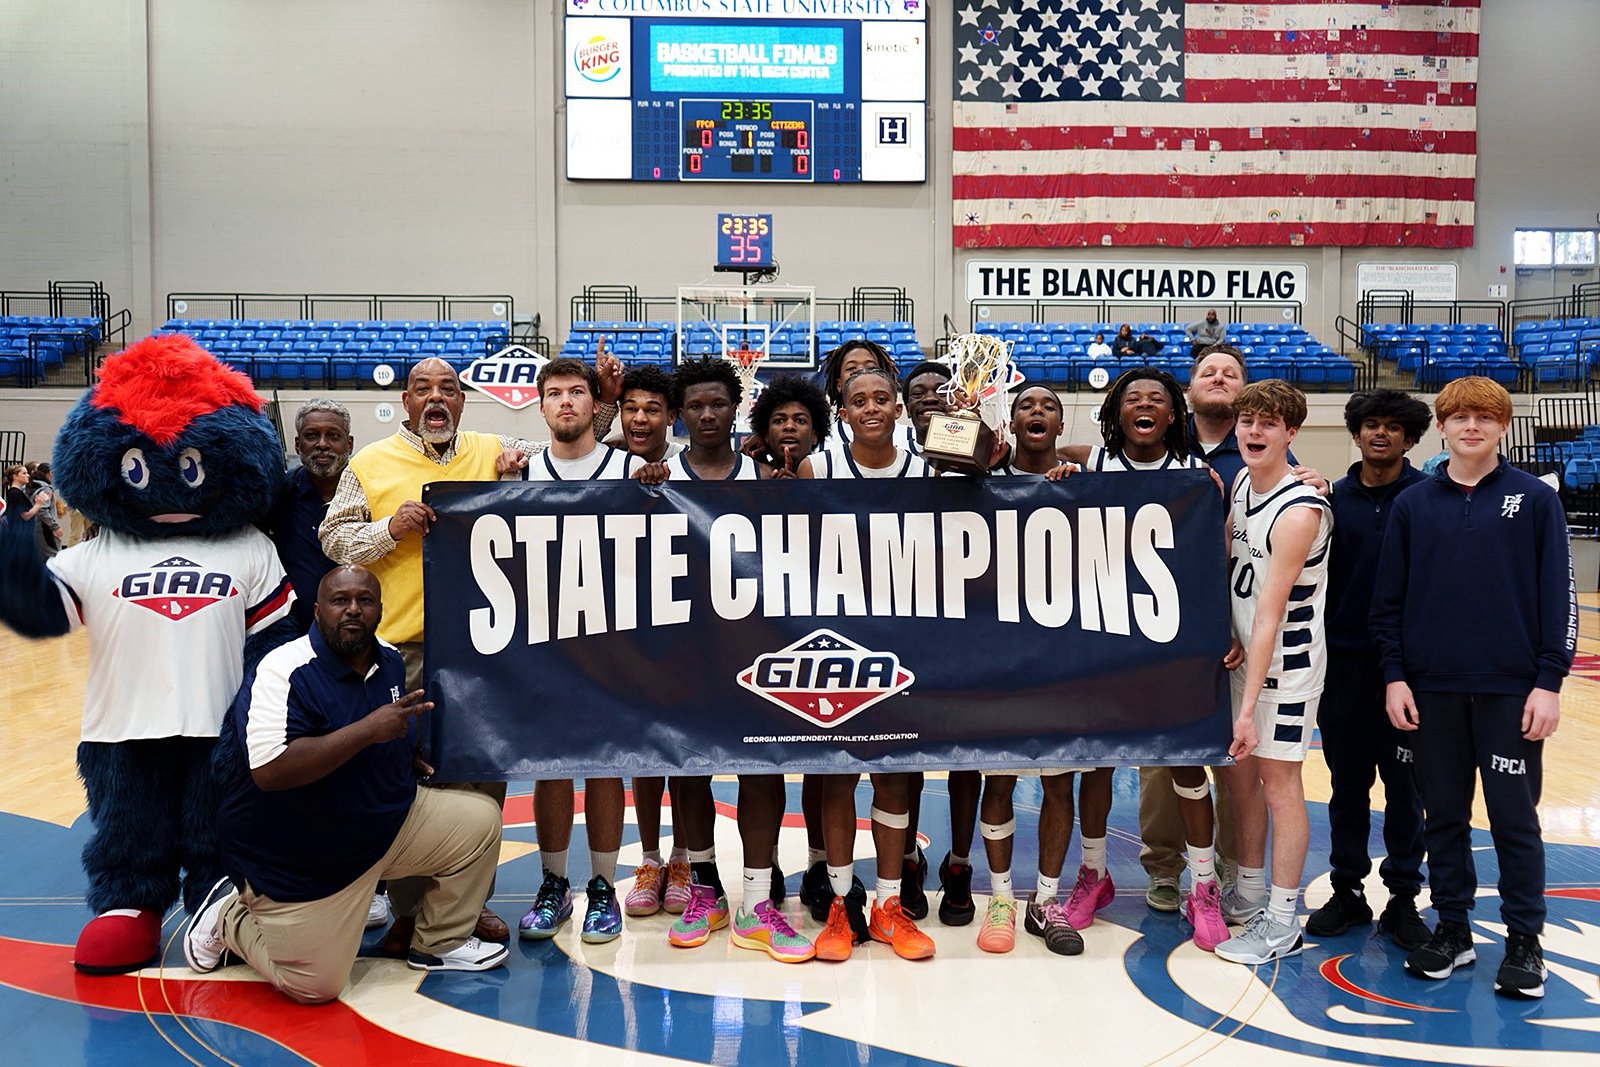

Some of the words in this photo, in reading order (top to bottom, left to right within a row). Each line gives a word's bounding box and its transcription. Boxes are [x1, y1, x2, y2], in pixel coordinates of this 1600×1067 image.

[599, 0, 711, 12] COLUMBUS
[720, 0, 774, 13] STATE
[783, 0, 894, 14] UNIVERSITY
[579, 41, 618, 58] BURGER
[657, 43, 769, 64] BASKETBALL
[773, 45, 837, 65] FINALS
[866, 42, 910, 53] kinetic
[581, 51, 620, 71] KING
[723, 65, 738, 78] BY
[739, 65, 760, 78] THE
[722, 103, 772, 119] 23:35
[696, 120, 715, 129] FPCA
[771, 121, 805, 130] CITIZENS
[881, 119, 905, 142] H
[702, 130, 712, 148] 0
[748, 131, 752, 148] 1
[797, 131, 808, 148] 0
[691, 155, 701, 173] 0
[797, 156, 808, 174] 0
[722, 218, 768, 235] 23:35
[730, 235, 761, 262] 35
[979, 268, 1031, 296] THE
[1043, 268, 1216, 298] BLANCHARD
[1227, 270, 1295, 299] FLAG
[378, 371, 389, 379] 110
[471, 362, 537, 384] GIA
[121, 571, 232, 598] GIAA
[469, 513, 691, 655] STATE
[709, 503, 1181, 643] CHAMPIONS
[755, 656, 895, 689] GIAA
[832, 734, 868, 742] ATHLETIC
[869, 733, 919, 741] ASSOCIATION
[1492, 754, 1526, 775] FPCA
